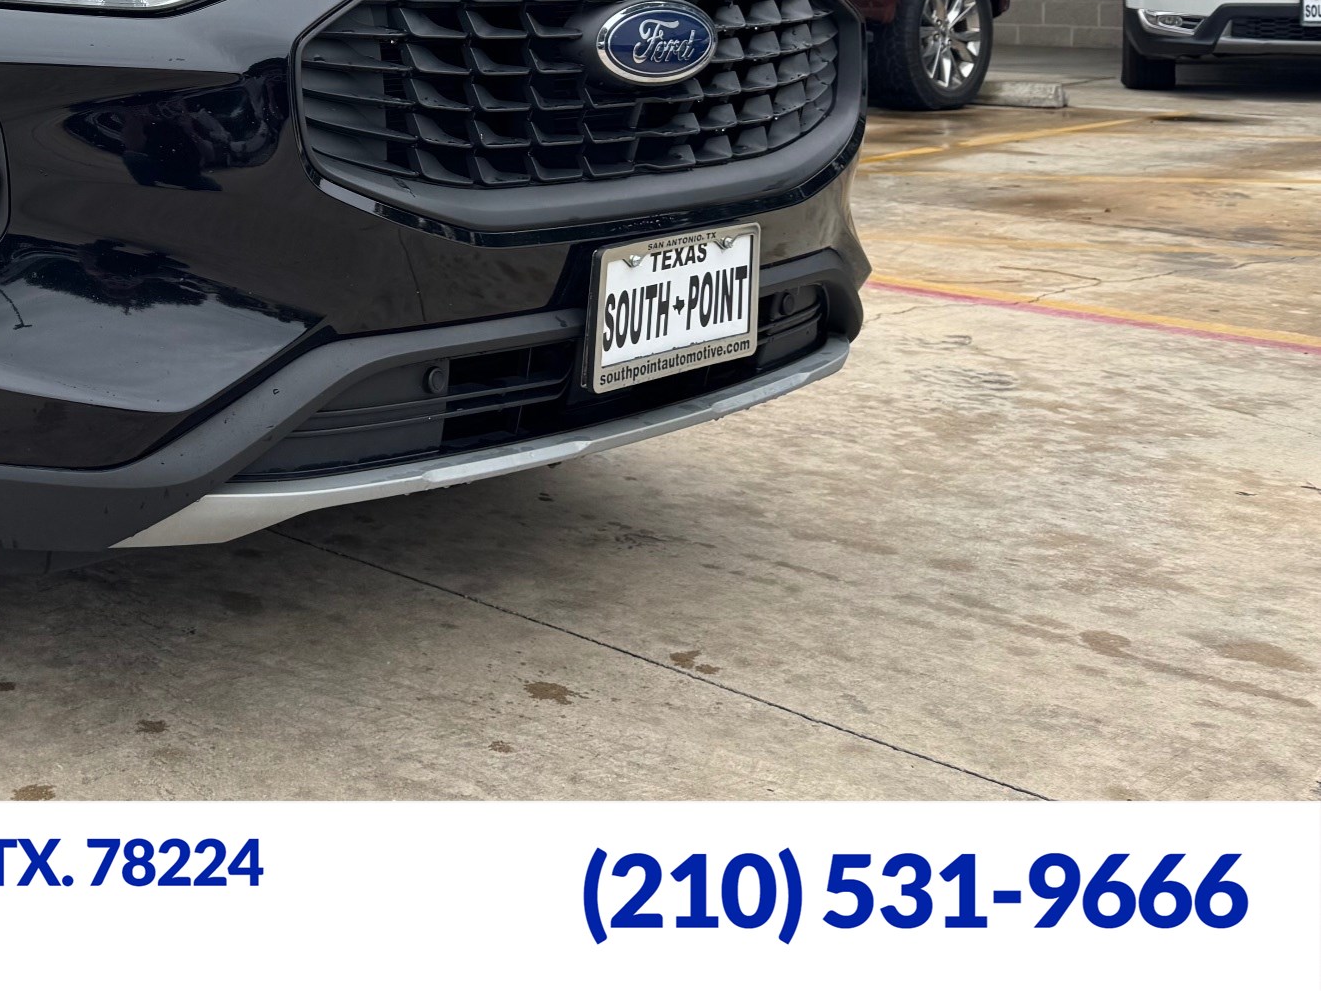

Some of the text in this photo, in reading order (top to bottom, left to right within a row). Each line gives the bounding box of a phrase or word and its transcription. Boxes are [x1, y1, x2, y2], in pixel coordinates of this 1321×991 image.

[632, 18, 696, 64] Ford
[647, 241, 664, 251] SAN
[706, 231, 717, 240] TX
[650, 242, 708, 273] TEXAS
[602, 265, 748, 352] SOUTH POINT
[599, 338, 751, 386] southpointautomotive.com
